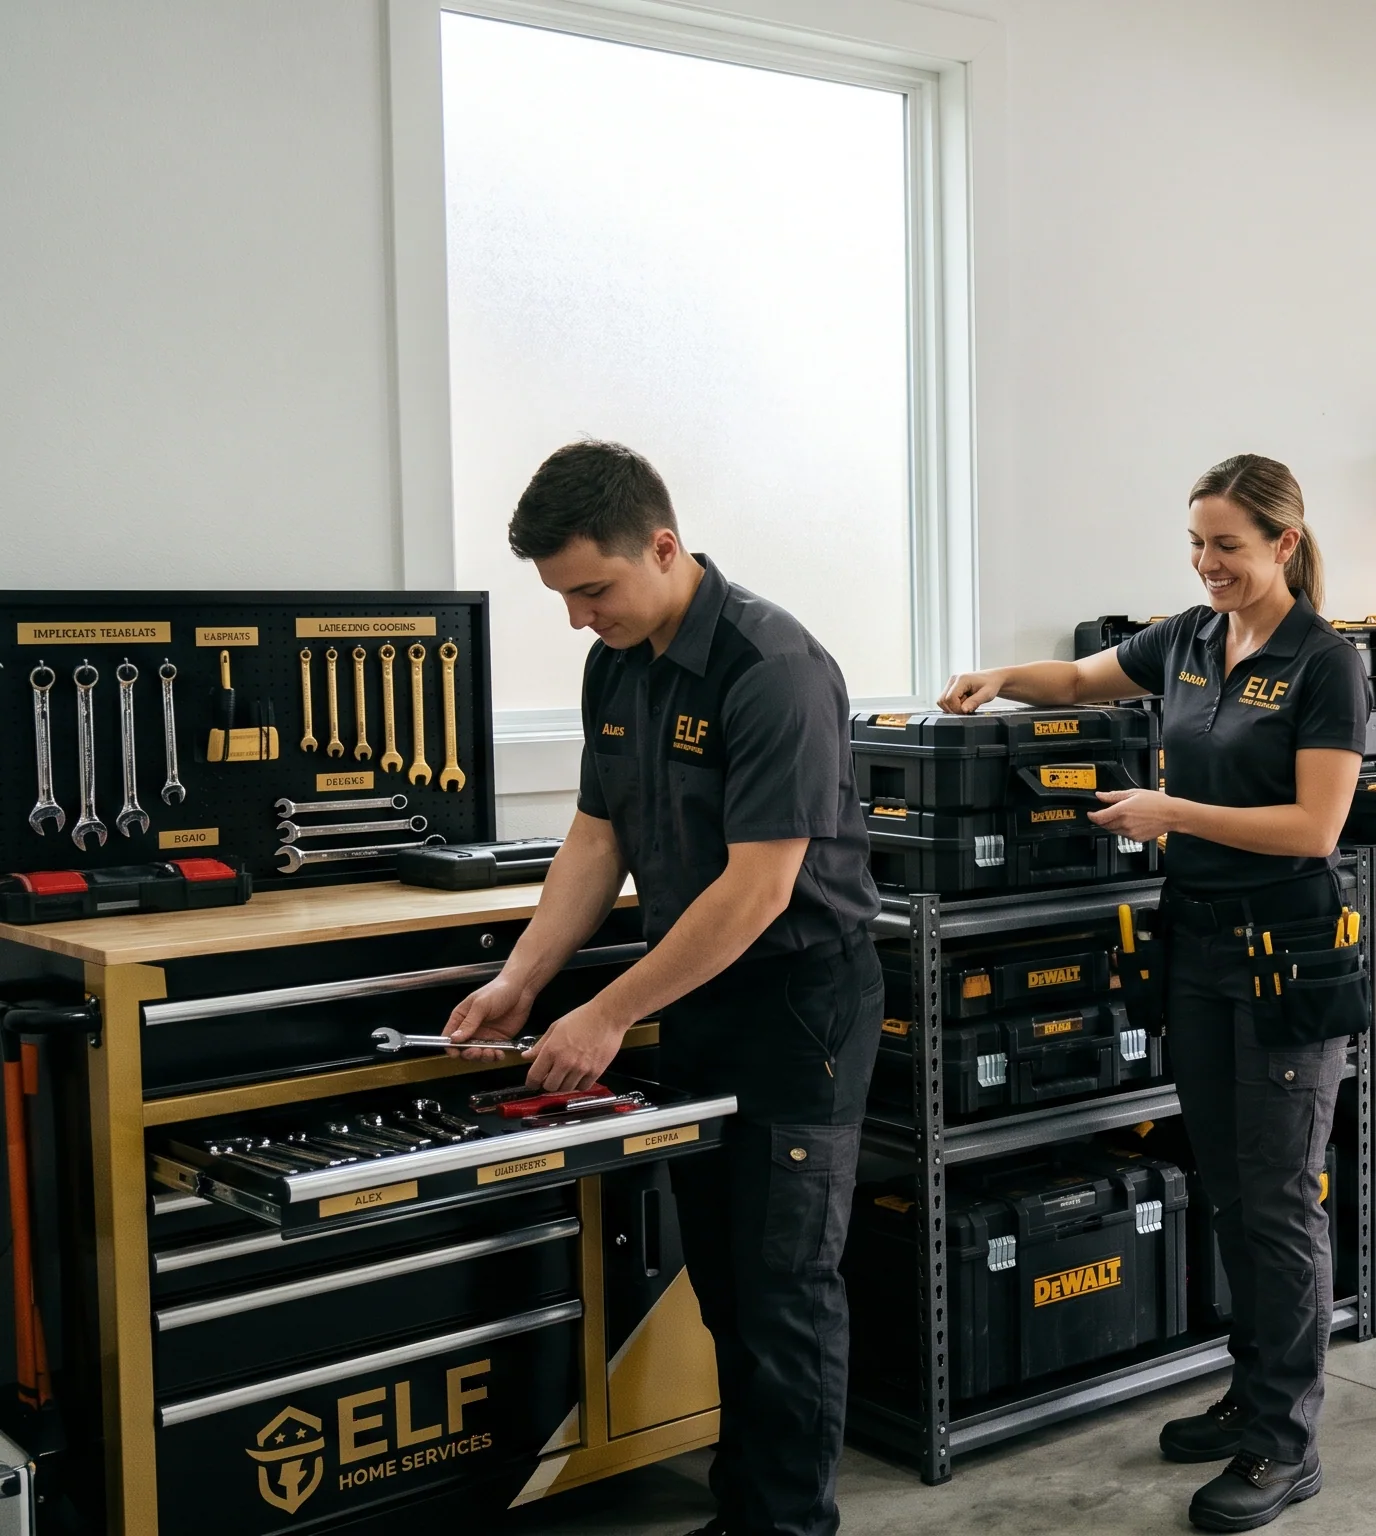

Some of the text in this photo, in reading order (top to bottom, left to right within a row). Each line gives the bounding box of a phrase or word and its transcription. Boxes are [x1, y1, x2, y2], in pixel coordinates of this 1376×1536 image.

[1242, 676, 1290, 702] ELF
[675, 715, 709, 744] ELF
[1028, 968, 1080, 987] DEWALT
[354, 1192, 383, 1206] ALEX
[1034, 1259, 1121, 1304] DEWALT
[337, 1358, 491, 1466] ELF
[339, 1432, 493, 1491] HOME SERVICES
